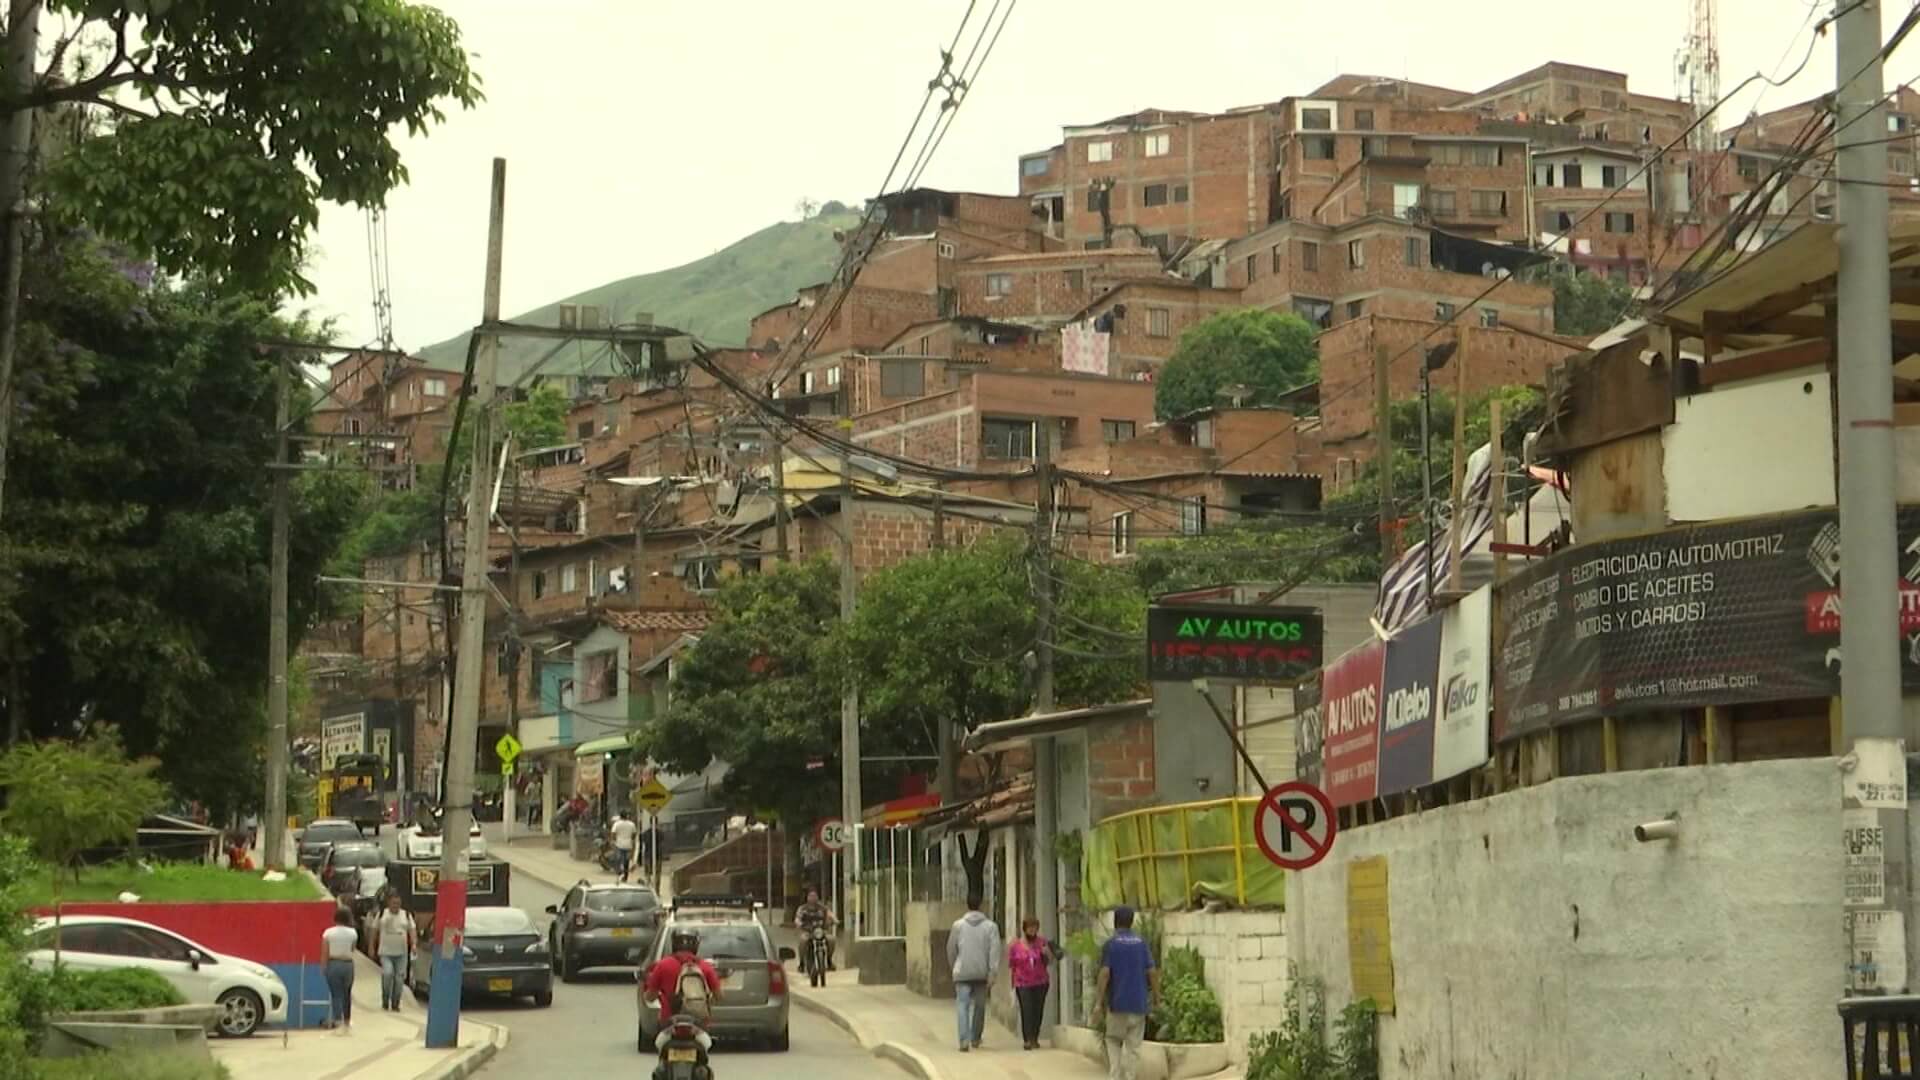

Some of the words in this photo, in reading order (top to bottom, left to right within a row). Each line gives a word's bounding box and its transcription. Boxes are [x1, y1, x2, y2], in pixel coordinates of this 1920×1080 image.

[1667, 534, 1785, 569] AUTOMOTRIZ
[1616, 582, 1640, 604] DE
[1643, 572, 1715, 600] ACEITES
[1177, 617, 1212, 638] AV
[1215, 619, 1303, 642] AUTOS
[1615, 611, 1628, 632] Y
[1630, 601, 1706, 629] CARROS)
[1340, 683, 1377, 736] AUTOS
[1279, 798, 1317, 853] P
